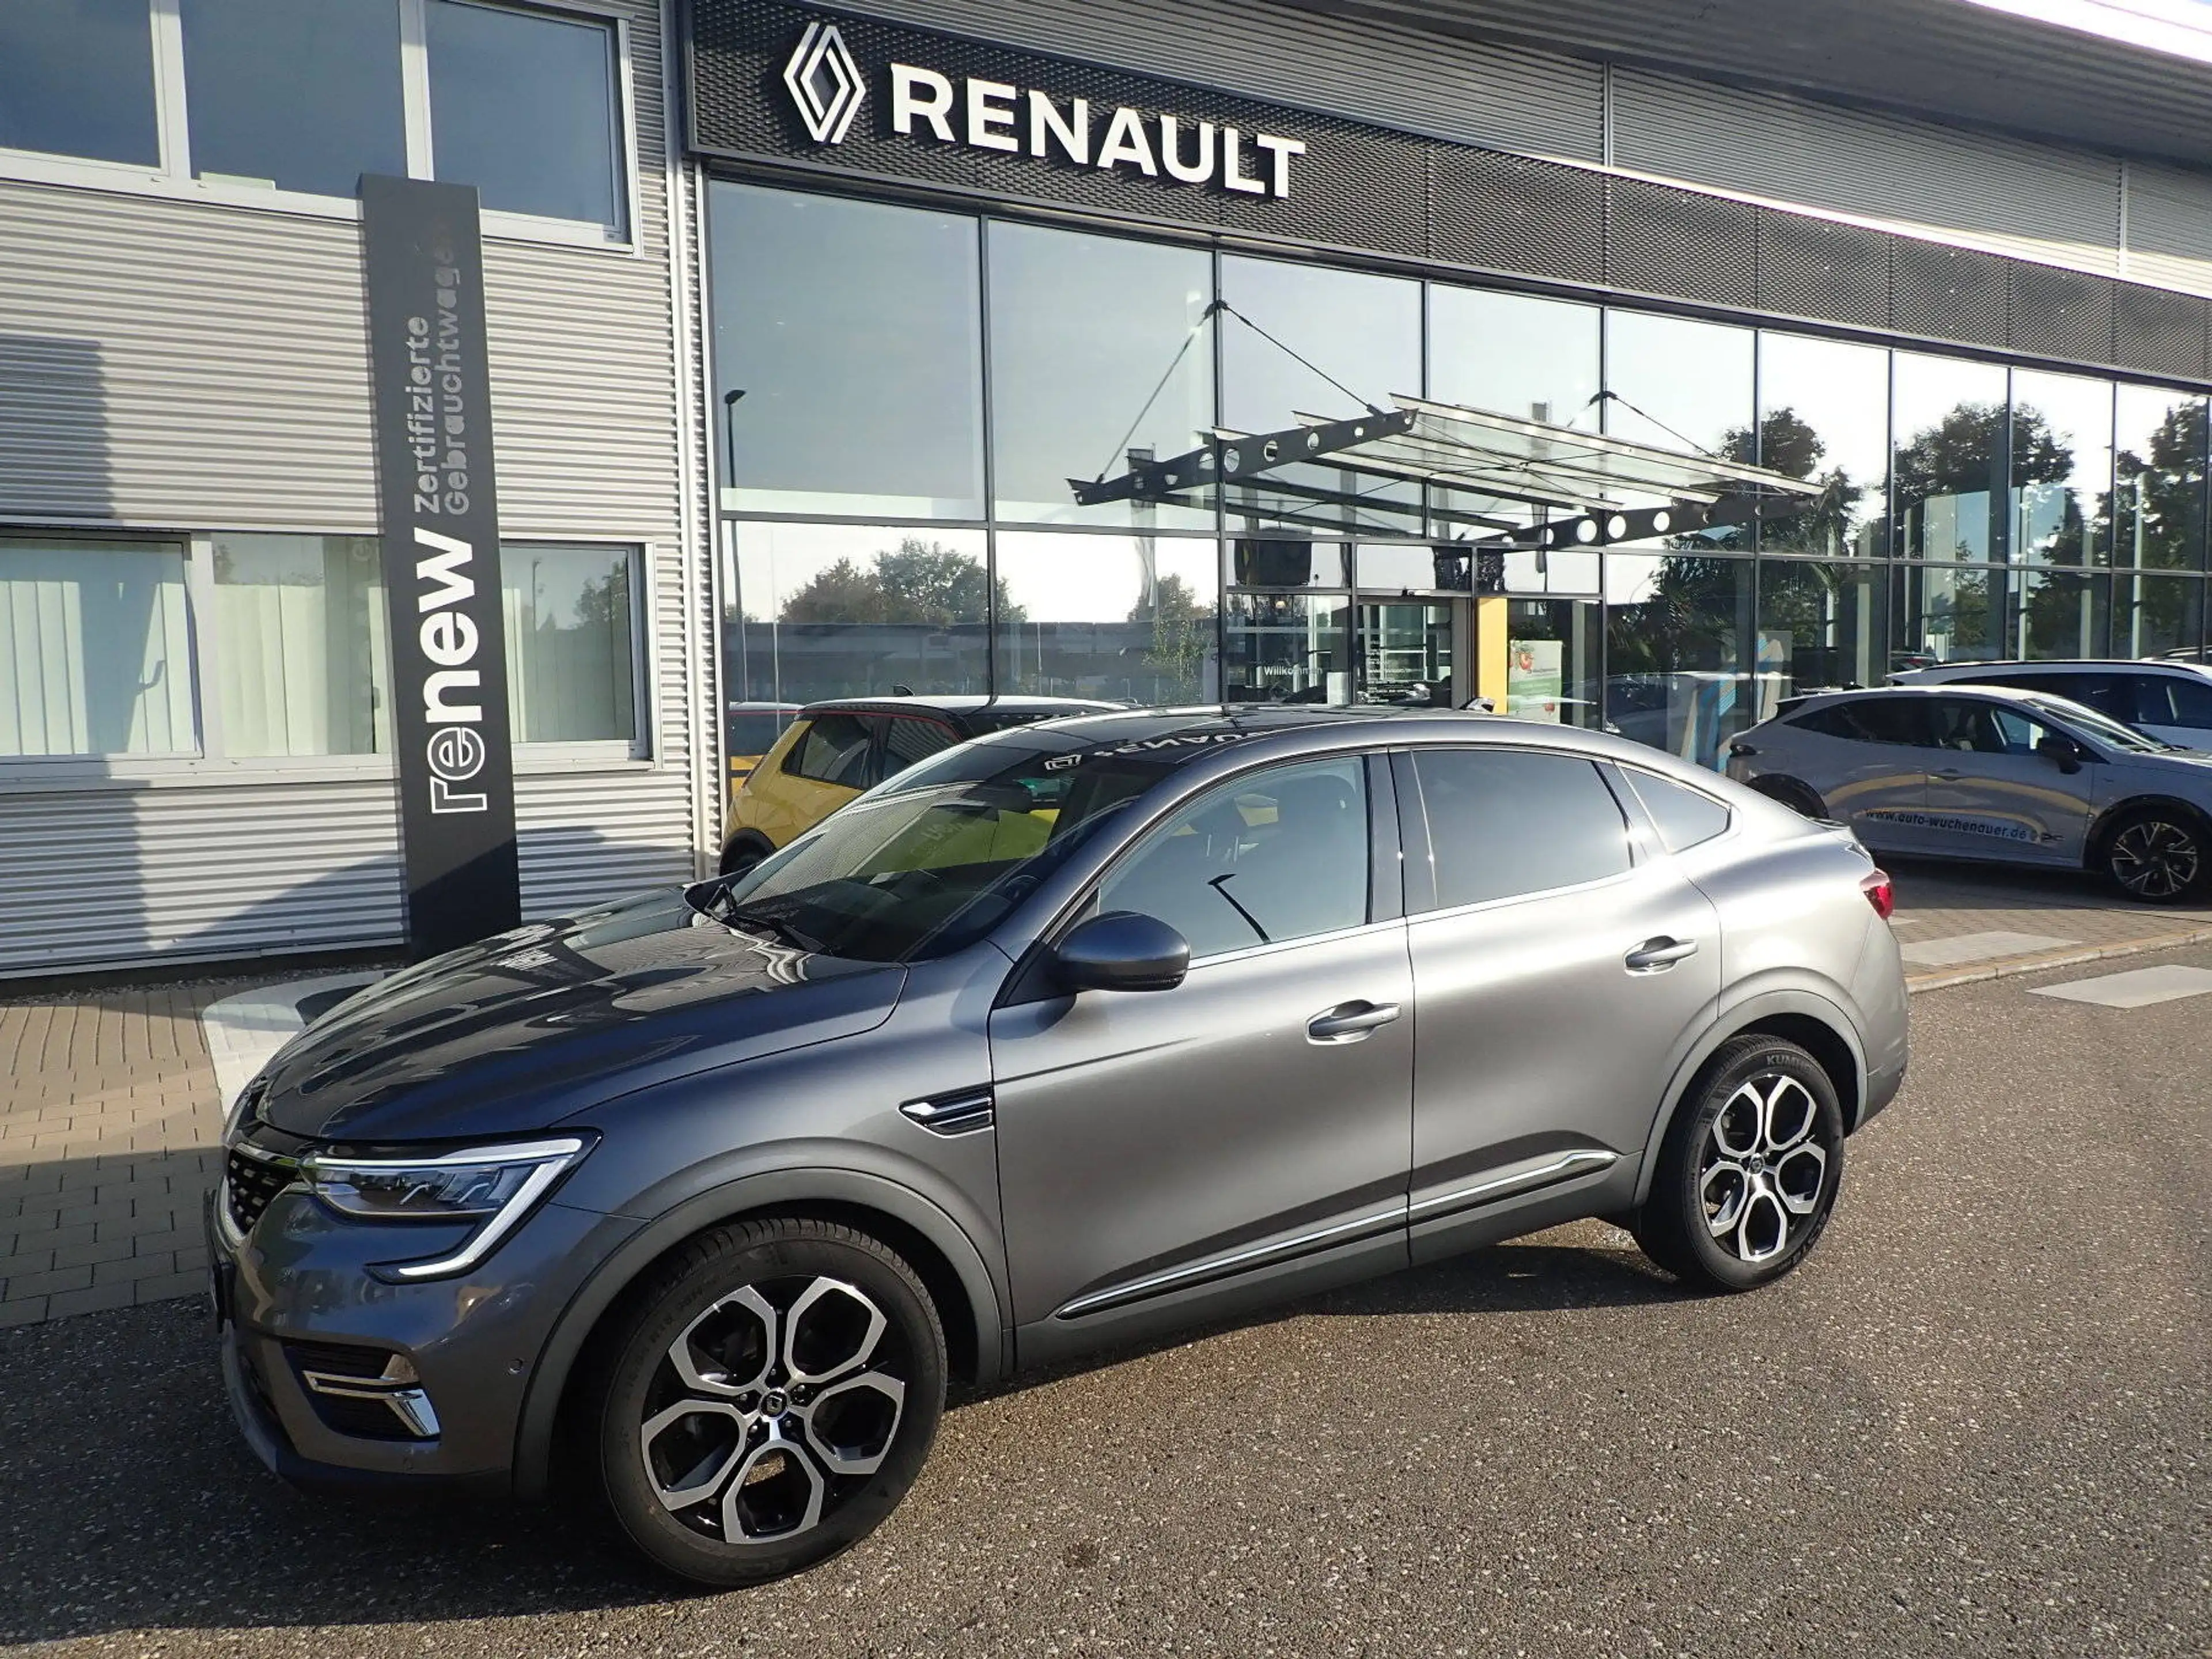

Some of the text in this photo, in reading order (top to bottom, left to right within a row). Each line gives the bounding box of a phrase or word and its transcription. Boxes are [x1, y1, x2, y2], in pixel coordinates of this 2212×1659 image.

[891, 63, 1306, 198] RENAULT
[406, 316, 440, 514] Zertifizierte
[434, 224, 469, 516] Gebrauchtwage
[414, 527, 487, 814] renew
